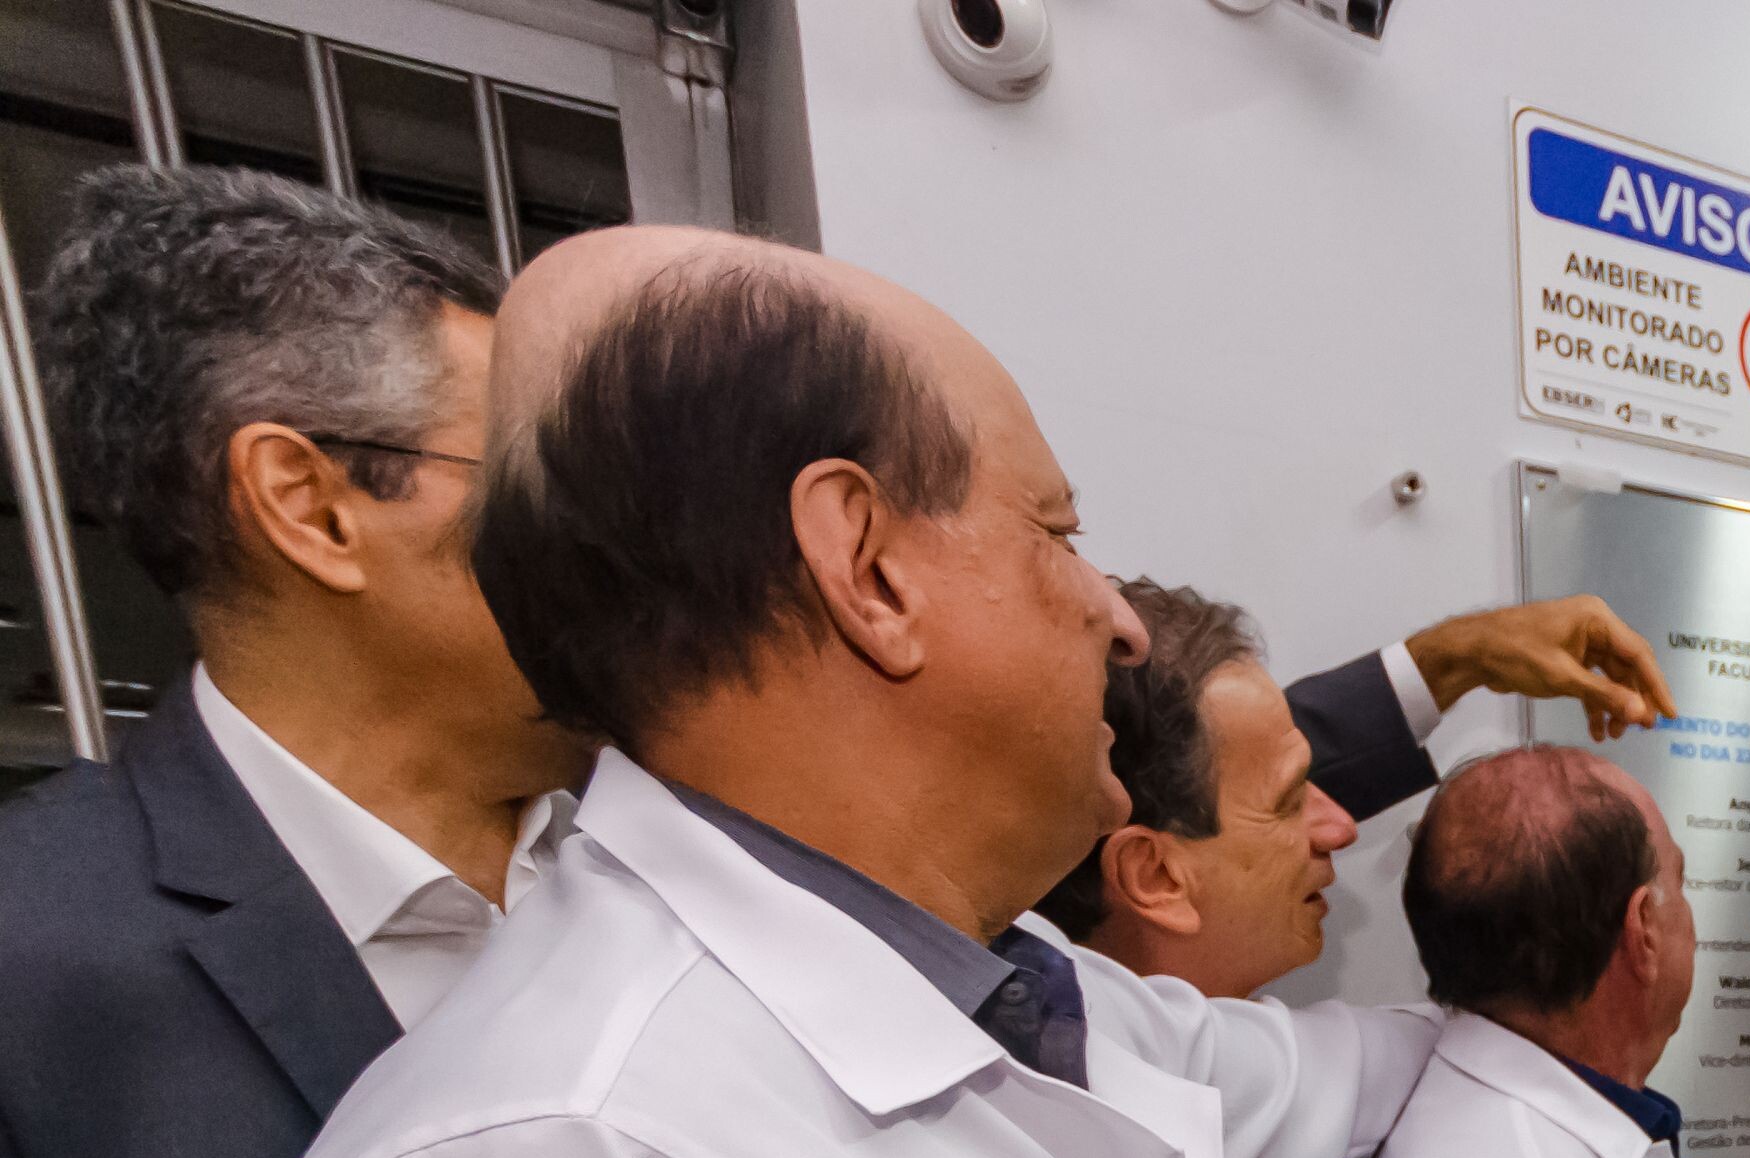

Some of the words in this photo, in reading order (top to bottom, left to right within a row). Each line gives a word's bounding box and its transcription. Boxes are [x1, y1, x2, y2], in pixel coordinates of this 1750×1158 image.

[1565, 252, 1702, 310] AMBIENTE
[1542, 288, 1724, 354] MONITORADO
[1535, 328, 1594, 364] POR
[1602, 343, 1731, 397] CÂMERAS
[1669, 741, 1697, 759] NO
[1701, 743, 1730, 763] DIA
[1726, 721, 1750, 738] DO
